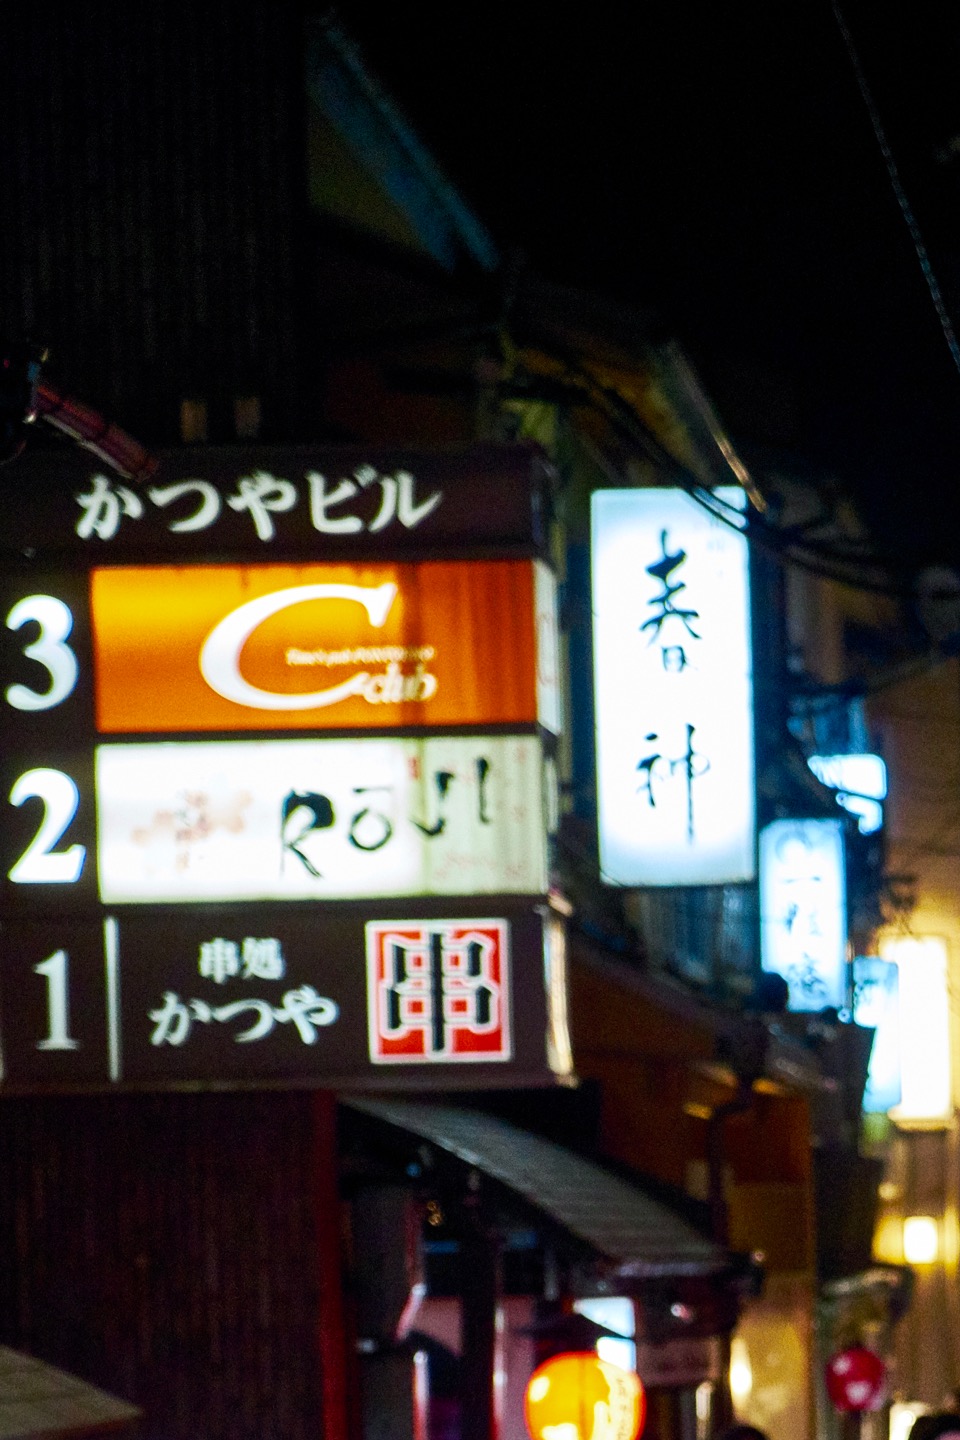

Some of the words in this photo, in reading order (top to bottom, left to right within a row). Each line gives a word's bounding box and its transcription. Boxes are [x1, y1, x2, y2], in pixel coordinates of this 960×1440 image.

[76, 467, 441, 541] かつやビル
[5, 594, 78, 712] 3
[8, 768, 86, 883] 2
[34, 949, 79, 1051] 1
[149, 985, 338, 1045] かつや
